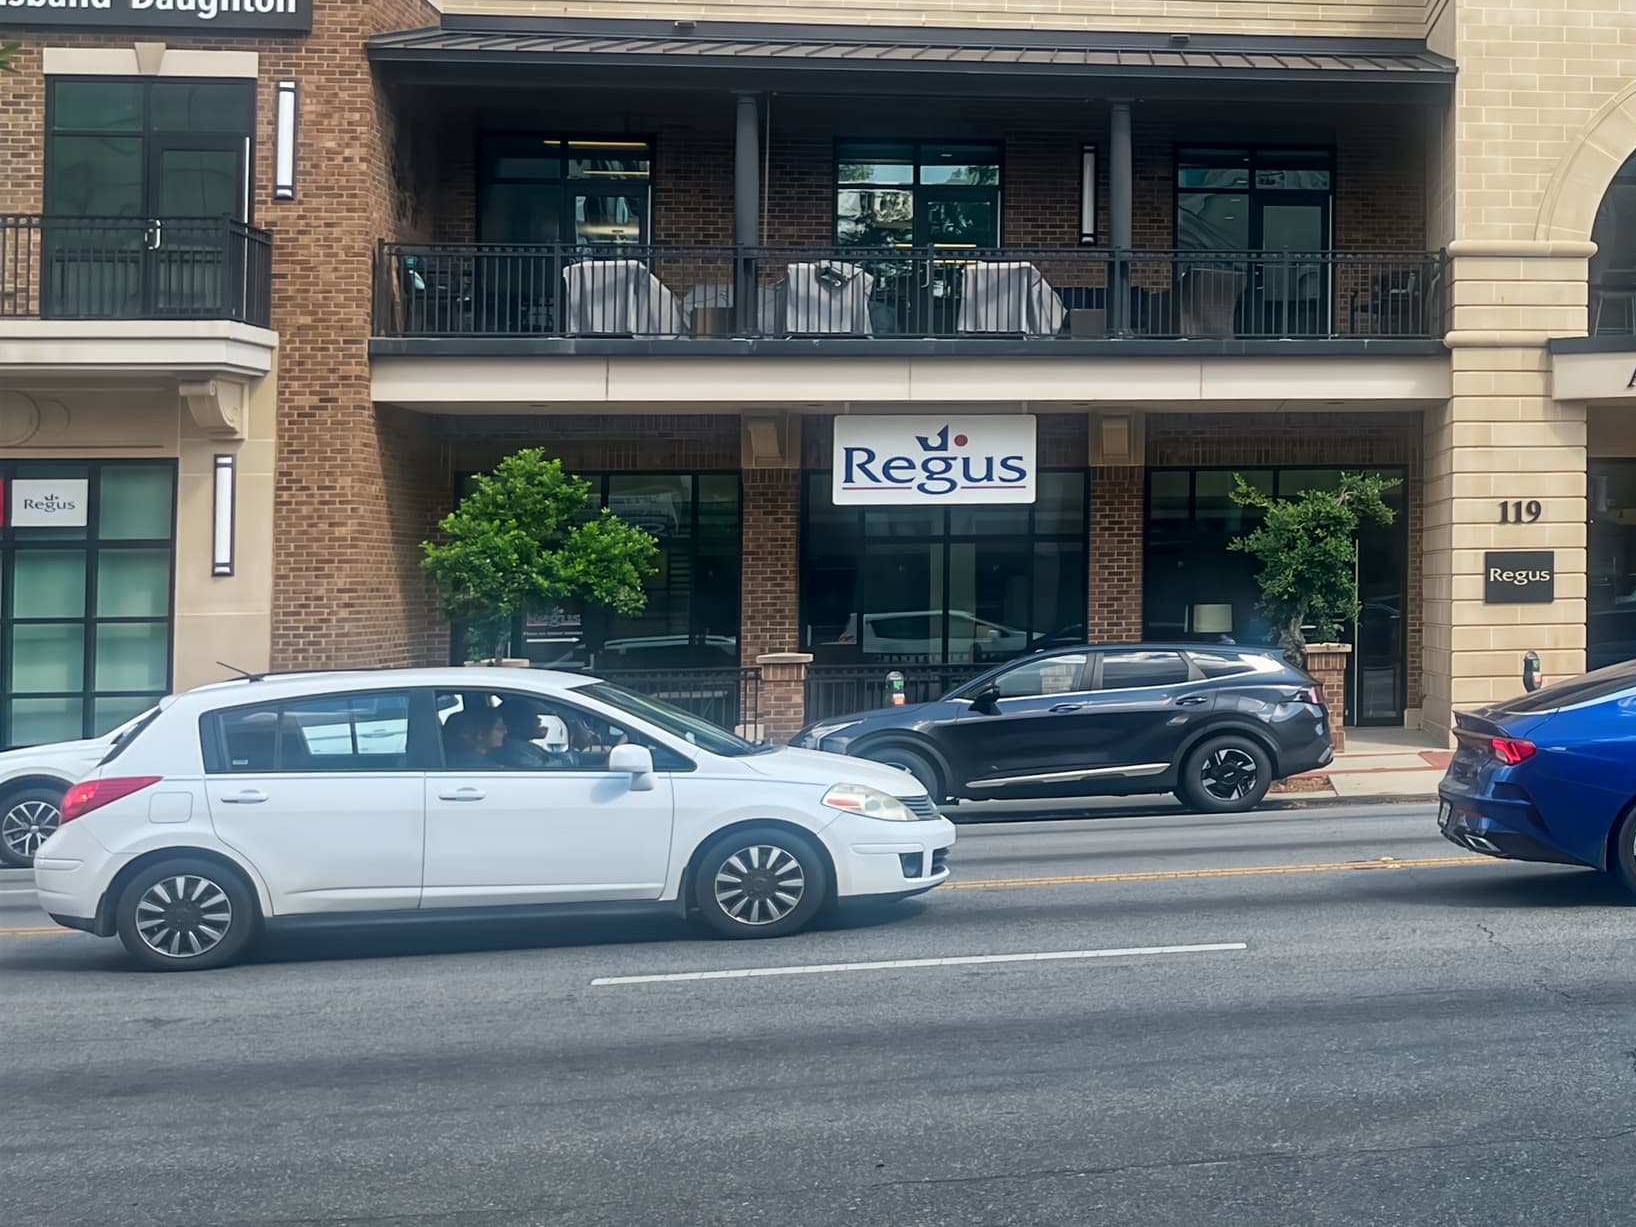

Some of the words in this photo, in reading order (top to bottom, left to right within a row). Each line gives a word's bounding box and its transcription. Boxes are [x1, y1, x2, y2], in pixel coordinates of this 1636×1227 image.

[843, 446, 1027, 495] Regus
[23, 499, 76, 513] Regus
[1498, 500, 1542, 524] 119
[1489, 568, 1551, 586] Regus
